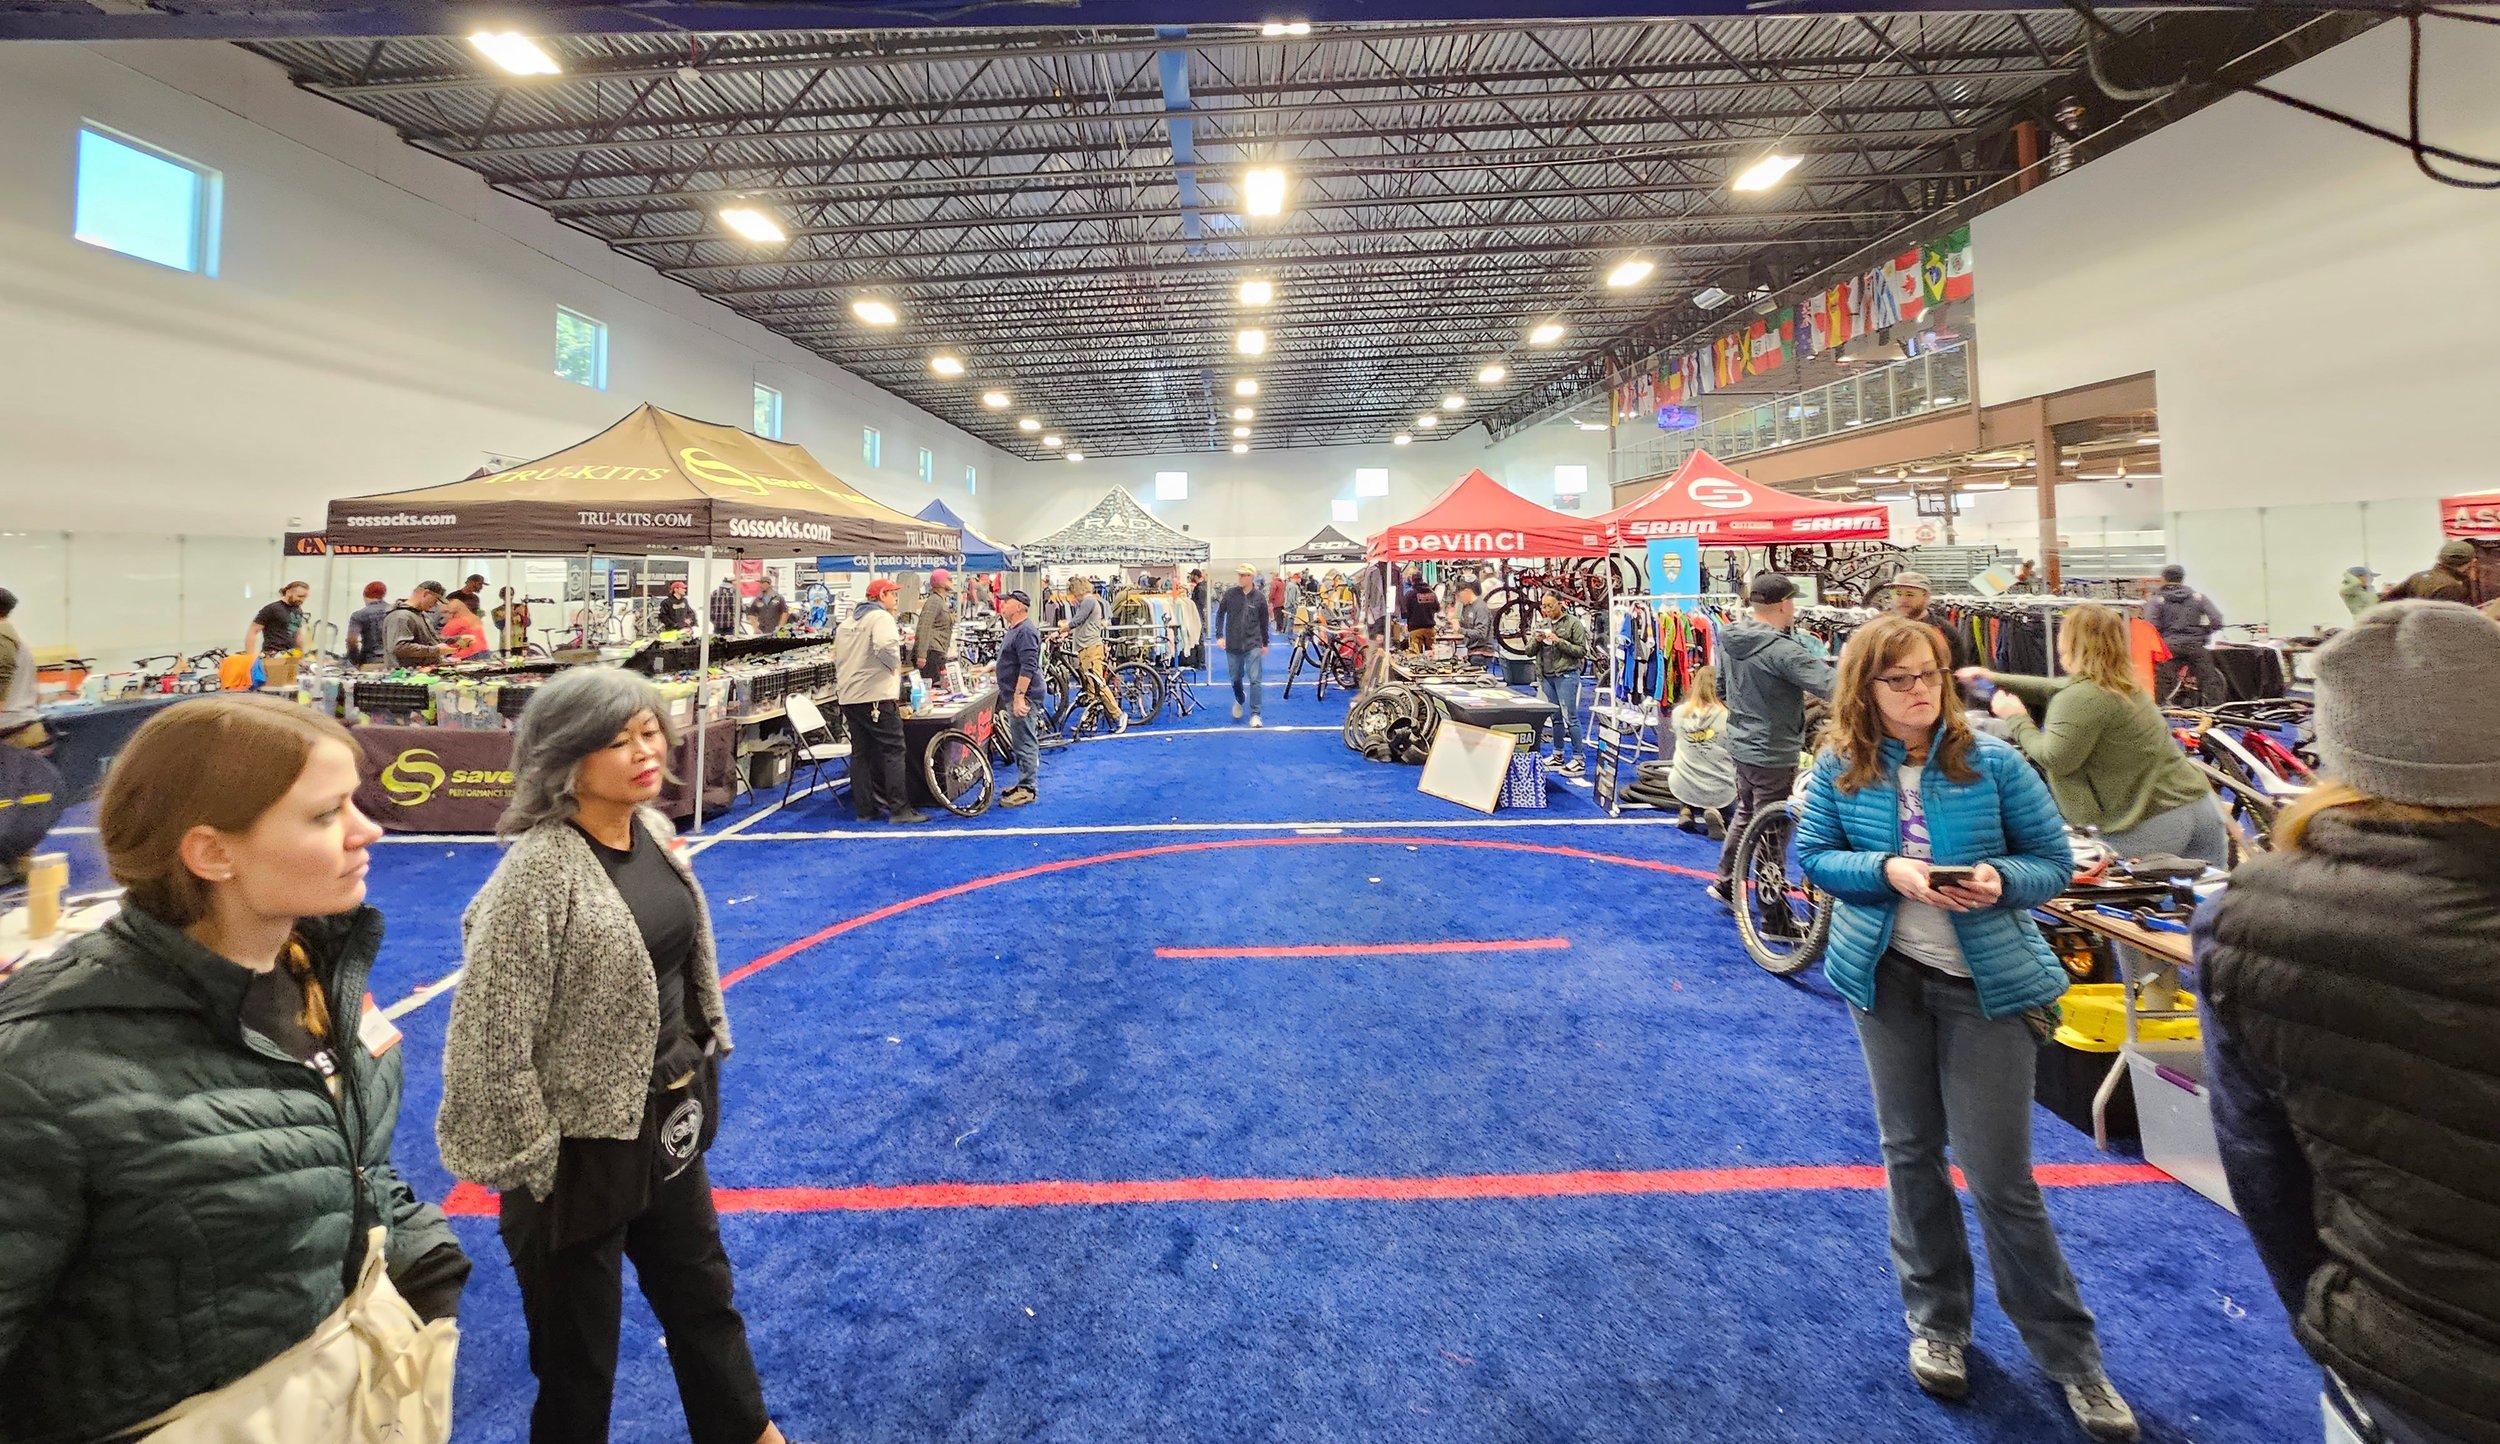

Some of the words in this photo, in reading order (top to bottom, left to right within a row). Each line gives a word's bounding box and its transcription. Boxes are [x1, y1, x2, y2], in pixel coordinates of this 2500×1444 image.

[484, 465, 670, 484] TRU-KITS
[347, 513, 457, 528] sossocks.com
[577, 511, 693, 528] TRU-KITS.COM
[1791, 517, 1883, 532] SRAM
[2454, 507, 2500, 528] AS
[729, 516, 832, 542] sossocks.com
[1629, 520, 1719, 535] SRAM
[853, 555, 903, 566] Coorado
[451, 770, 514, 784] save
